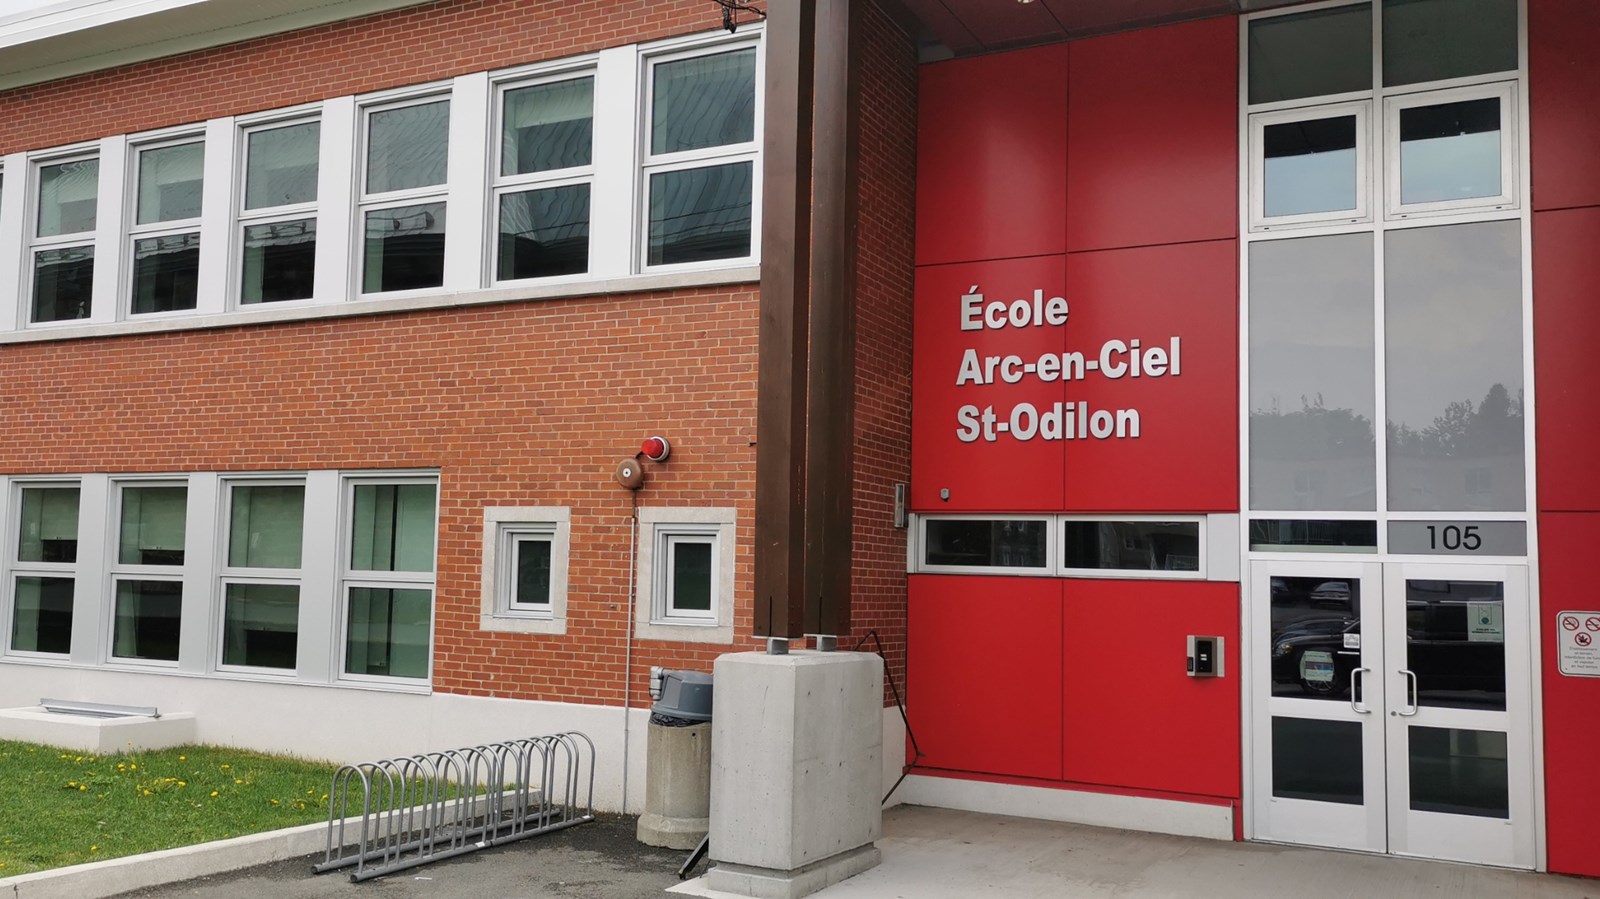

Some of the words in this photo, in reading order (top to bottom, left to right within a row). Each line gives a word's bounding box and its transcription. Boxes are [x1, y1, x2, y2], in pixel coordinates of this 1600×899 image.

[961, 285, 1069, 331] École
[956, 336, 1180, 386] Arc-en-Ciel
[956, 401, 1140, 442] St-Odilon
[1427, 525, 1481, 550] 105
